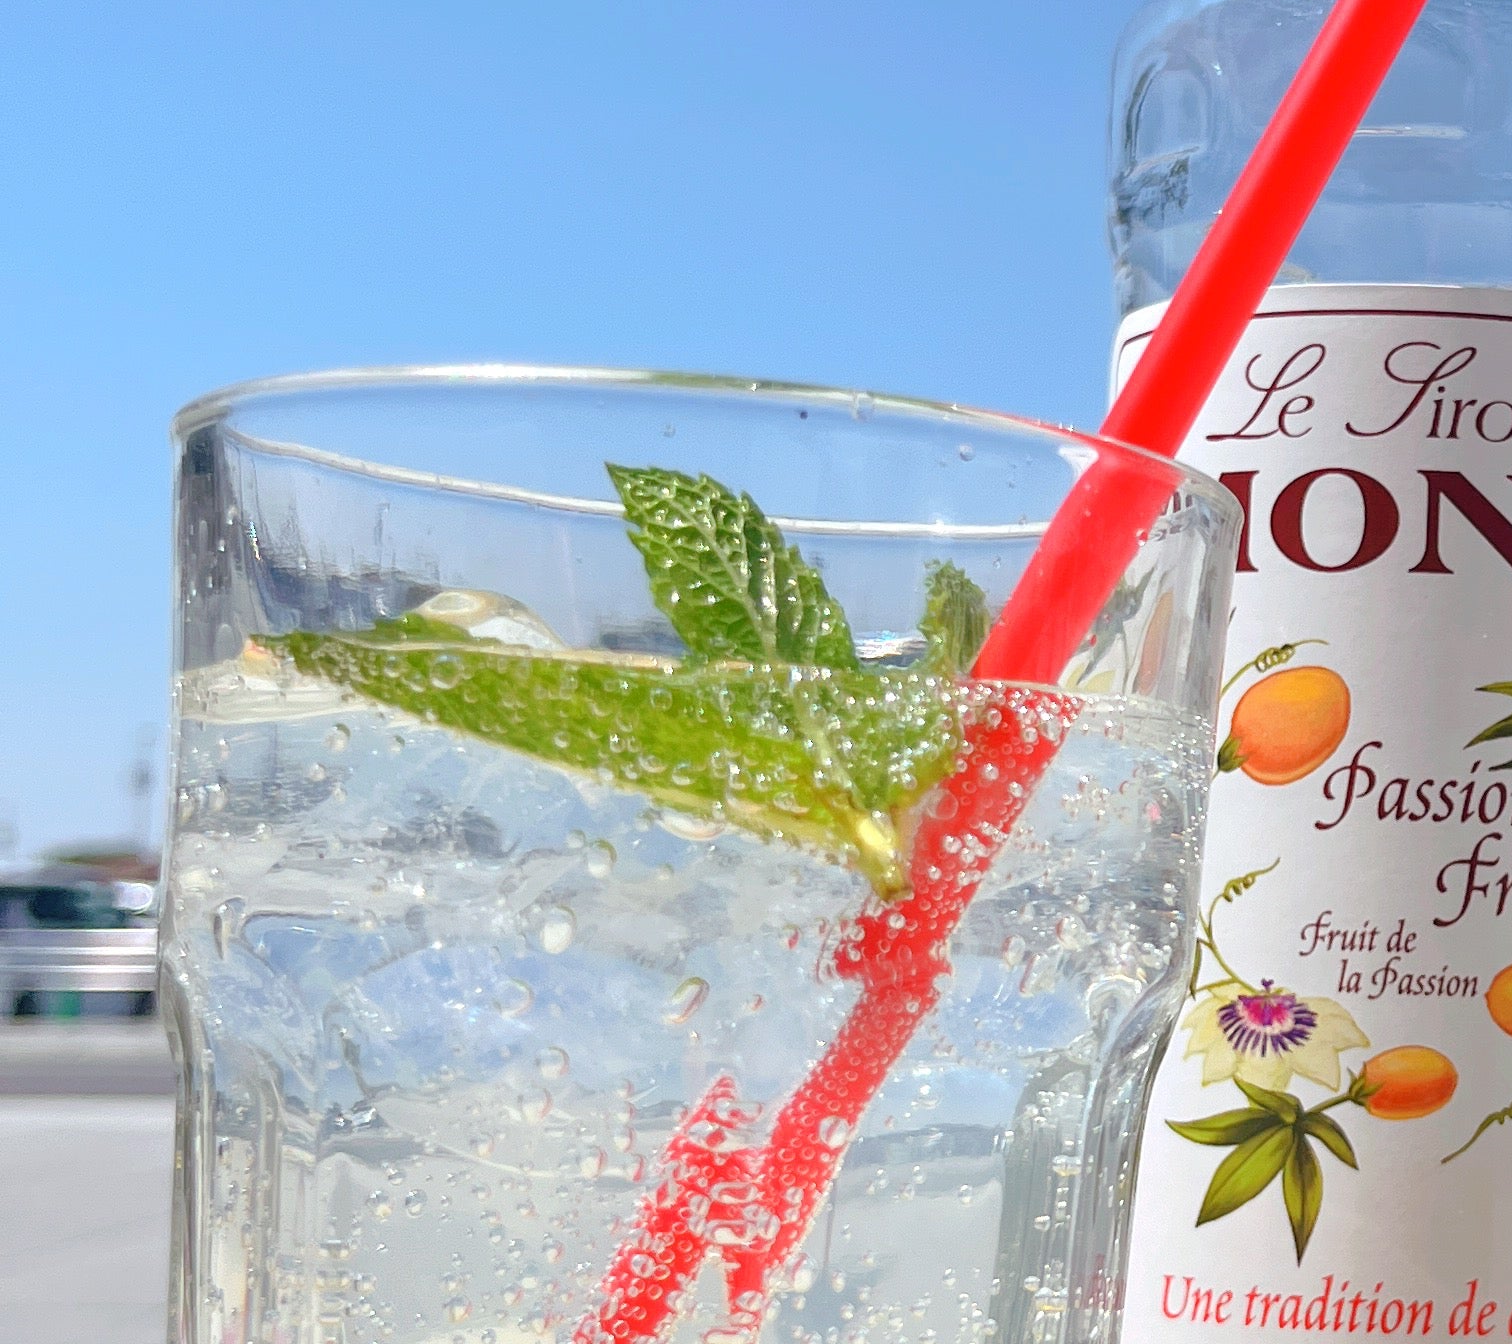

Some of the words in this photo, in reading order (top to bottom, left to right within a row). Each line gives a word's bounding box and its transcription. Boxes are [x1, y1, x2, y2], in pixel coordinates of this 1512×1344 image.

[1206, 343, 1326, 442] Le
[1299, 911, 1380, 957] Fruit
[1386, 919, 1417, 955] de
[1337, 959, 1363, 995] la
[1368, 956, 1479, 1000] Passion
[1161, 1274, 1233, 1325] Une
[1243, 1274, 1434, 1337] tradition
[1449, 1279, 1497, 1337] de
